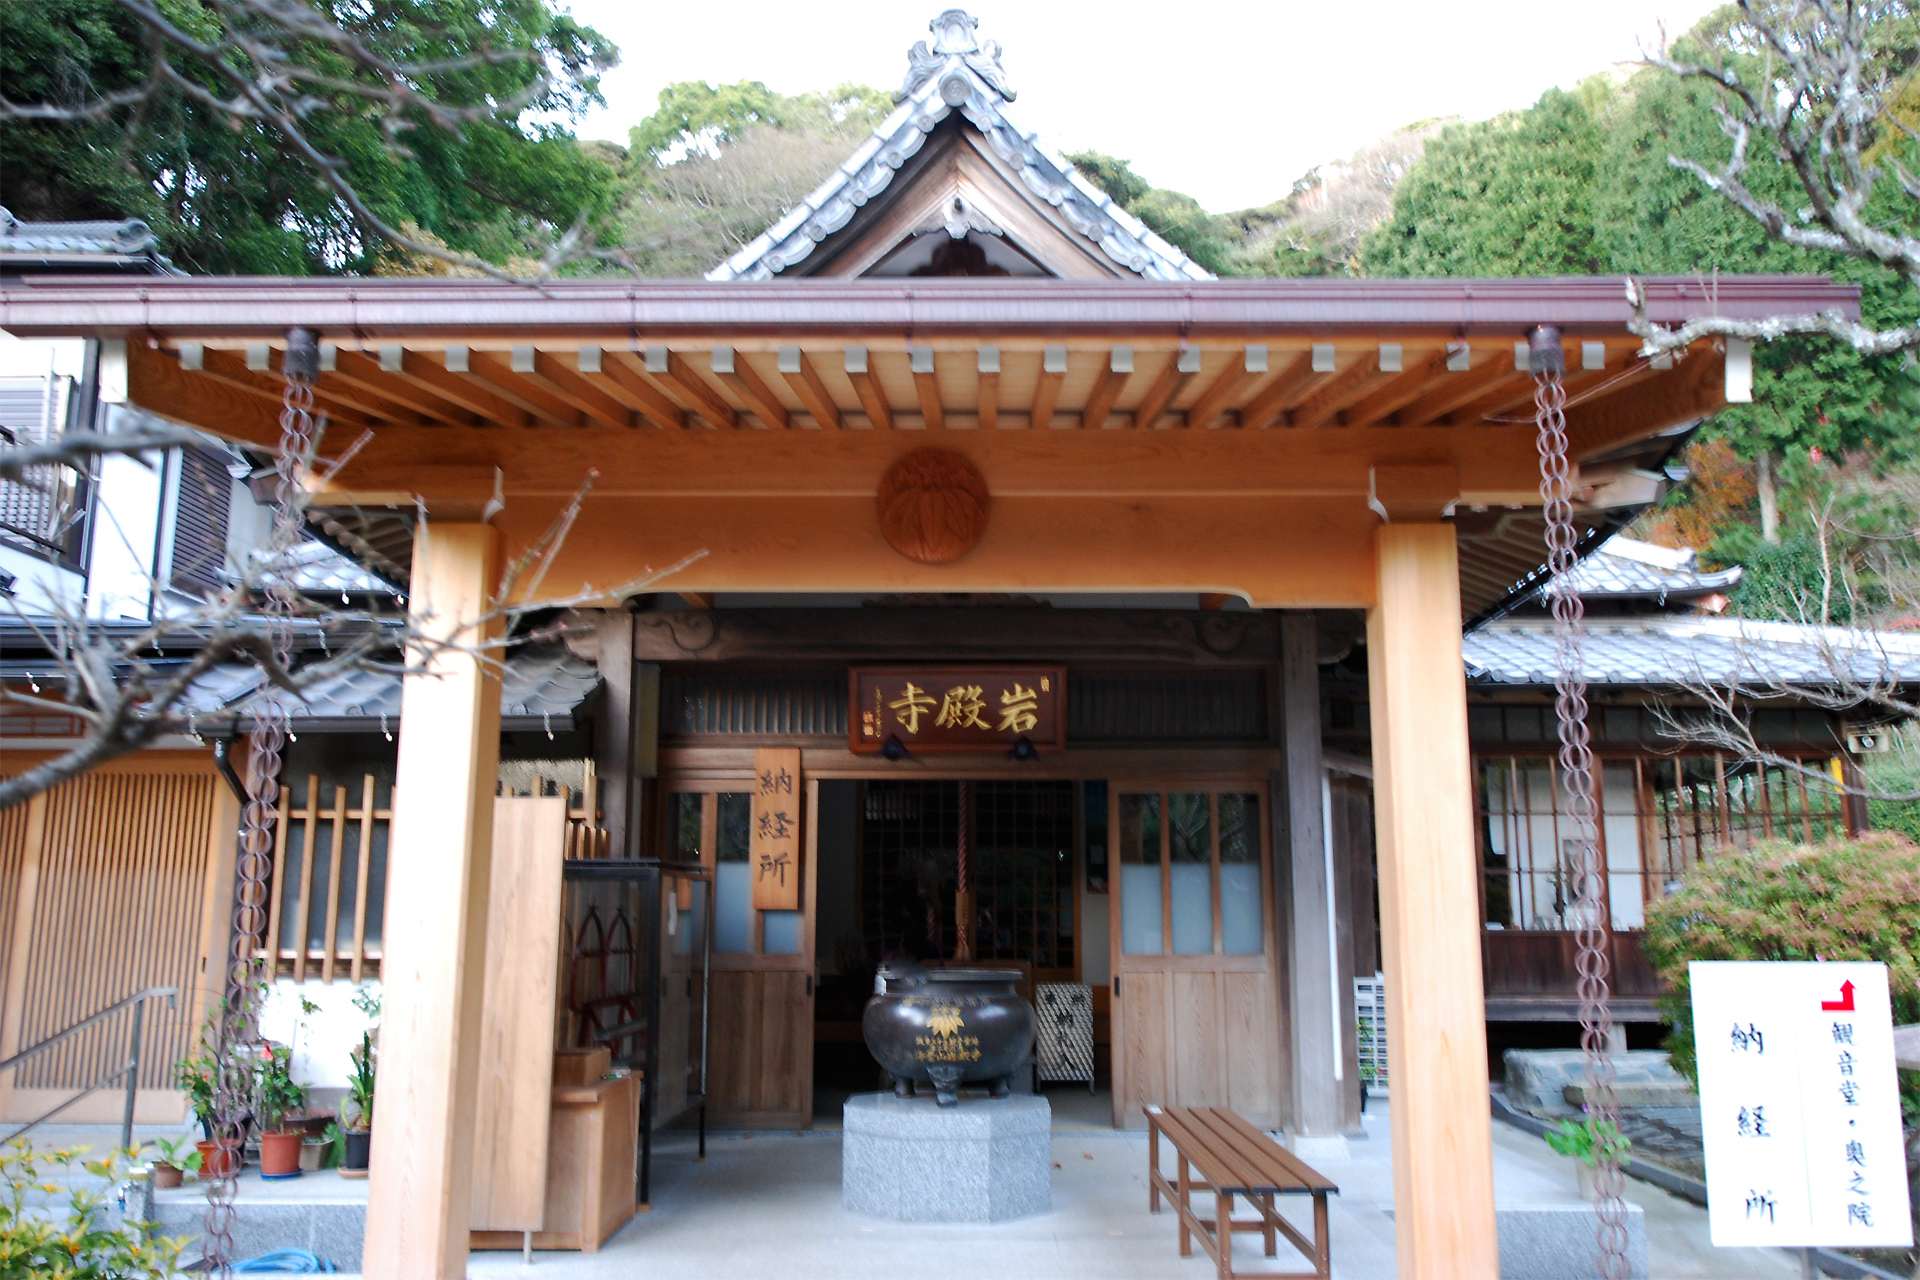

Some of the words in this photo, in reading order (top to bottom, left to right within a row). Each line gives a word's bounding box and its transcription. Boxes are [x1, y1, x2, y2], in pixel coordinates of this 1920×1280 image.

[888, 682, 1039, 734] 岩殿寺
[758, 767, 795, 888] 納経所
[1731, 1022, 1778, 1226] 納経所
